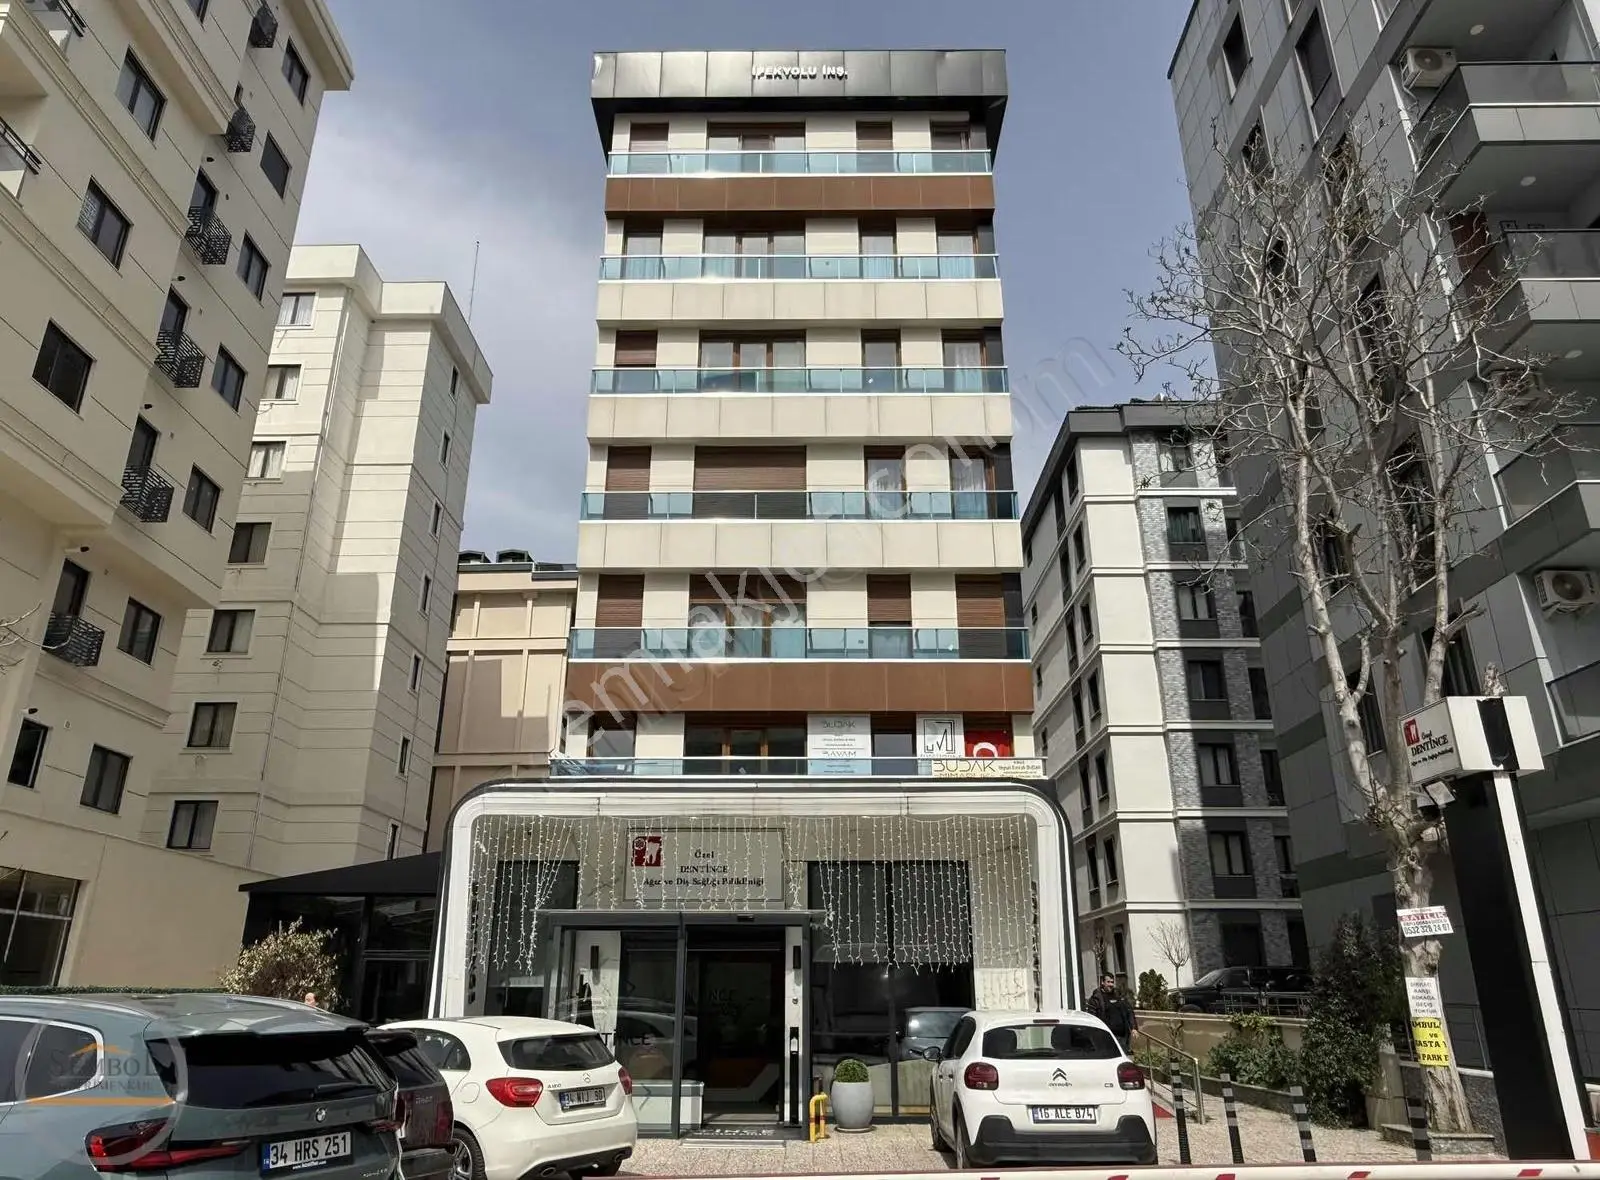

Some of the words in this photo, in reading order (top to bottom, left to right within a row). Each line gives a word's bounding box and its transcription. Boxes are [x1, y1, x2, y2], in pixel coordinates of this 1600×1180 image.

[1422, 1053, 1443, 1062] PARK
[1039, 1108, 1050, 1118] 16
[1055, 1108, 1072, 1118] ALE
[1075, 1108, 1093, 1118] 874
[270, 1143, 288, 1165] 34
[294, 1140, 319, 1161] HRS
[324, 1134, 347, 1156] 251
